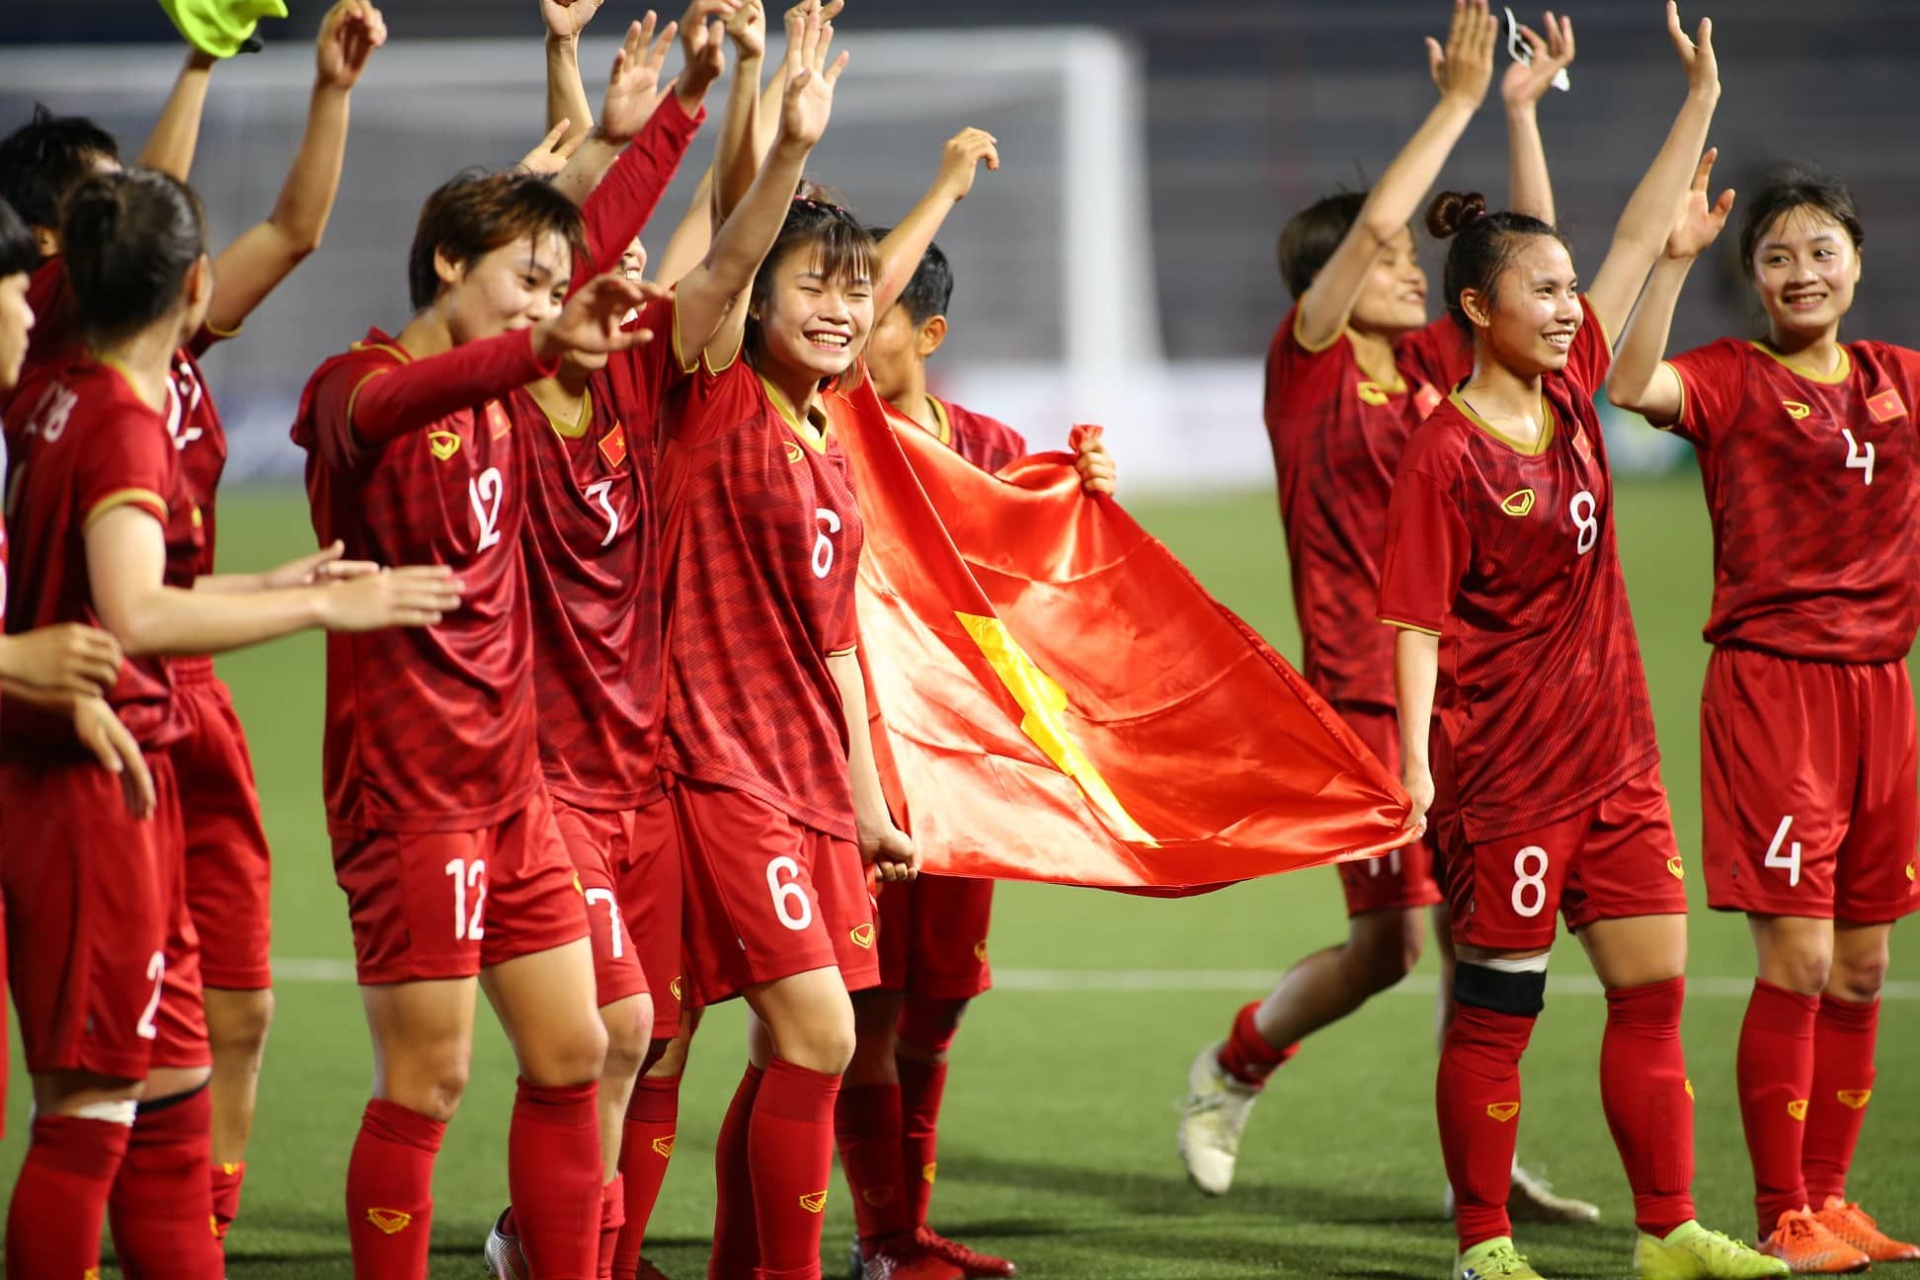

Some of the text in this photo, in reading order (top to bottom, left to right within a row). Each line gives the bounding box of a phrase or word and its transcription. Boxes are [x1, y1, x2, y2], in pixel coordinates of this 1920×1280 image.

[1842, 429, 1876, 486] 4
[468, 466, 503, 554] 12
[811, 507, 842, 579] 6
[1570, 490, 1599, 556] 8
[1511, 845, 1549, 918] 8
[1764, 815, 1802, 887] 4
[445, 858, 487, 941] 12
[584, 887, 624, 959] 7
[766, 855, 812, 931] 6
[136, 950, 166, 1040] 2
